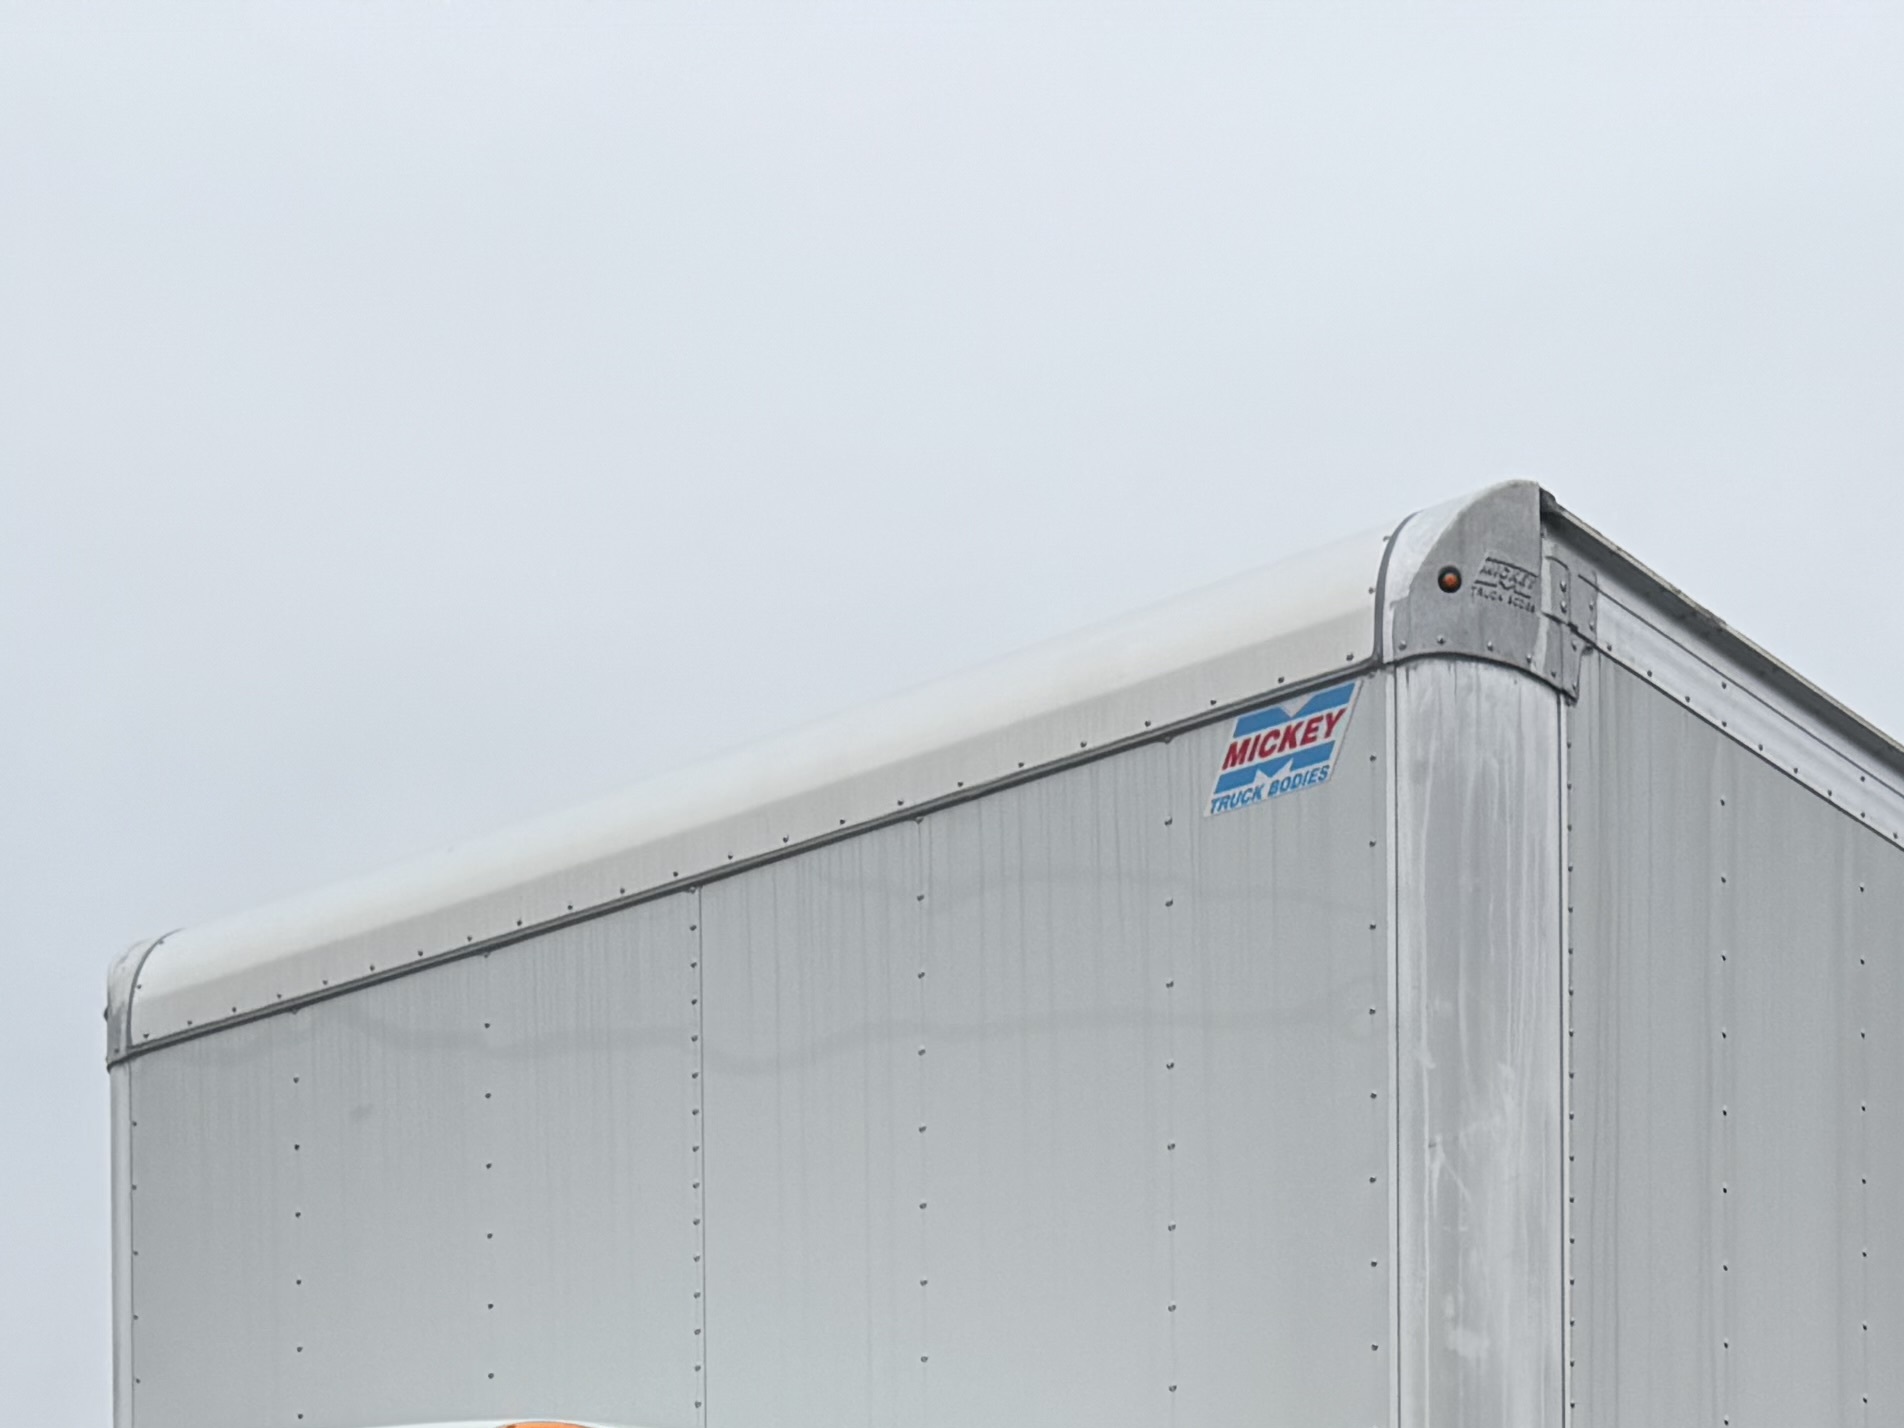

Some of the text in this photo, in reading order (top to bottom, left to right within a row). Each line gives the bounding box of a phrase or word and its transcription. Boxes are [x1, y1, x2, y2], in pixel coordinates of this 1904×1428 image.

[1222, 707, 1347, 771] MICKEY
[1210, 764, 1331, 815] TRUCK BODIES
